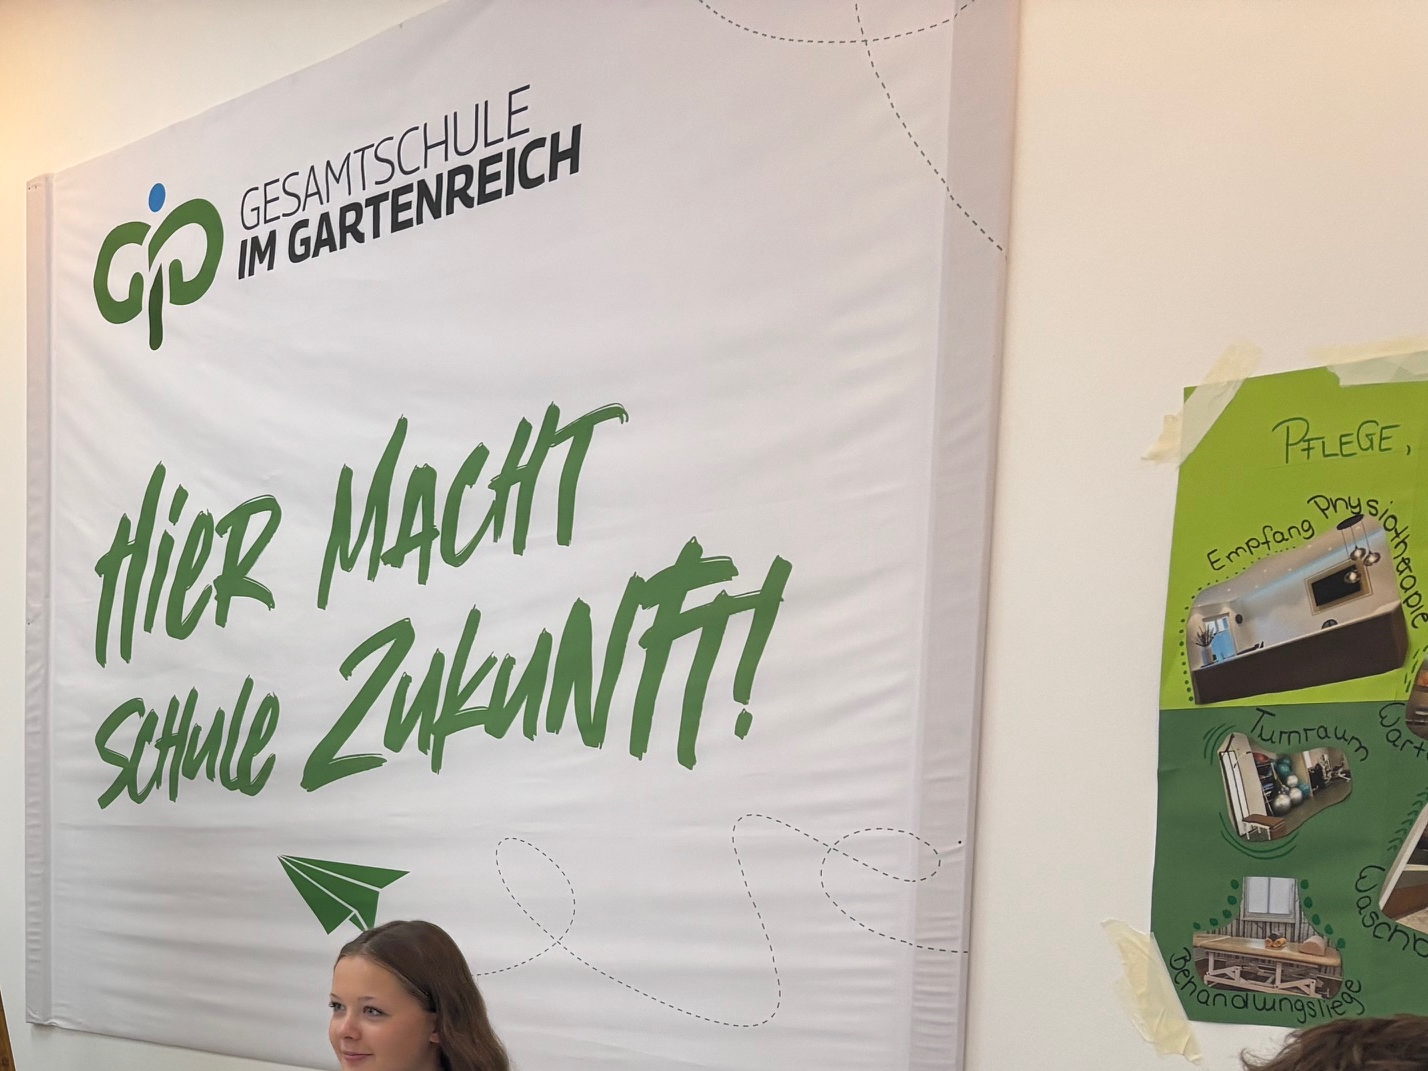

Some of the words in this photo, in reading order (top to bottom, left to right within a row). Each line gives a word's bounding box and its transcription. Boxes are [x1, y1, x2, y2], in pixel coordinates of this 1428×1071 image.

[237, 229, 277, 280] IM
[287, 123, 582, 264] GARTENREICH
[240, 84, 531, 231] GESAMTSCHULE
[316, 400, 629, 611] MACHT
[1207, 519, 1316, 571] Empfang
[1379, 702, 1428, 759] Wart
